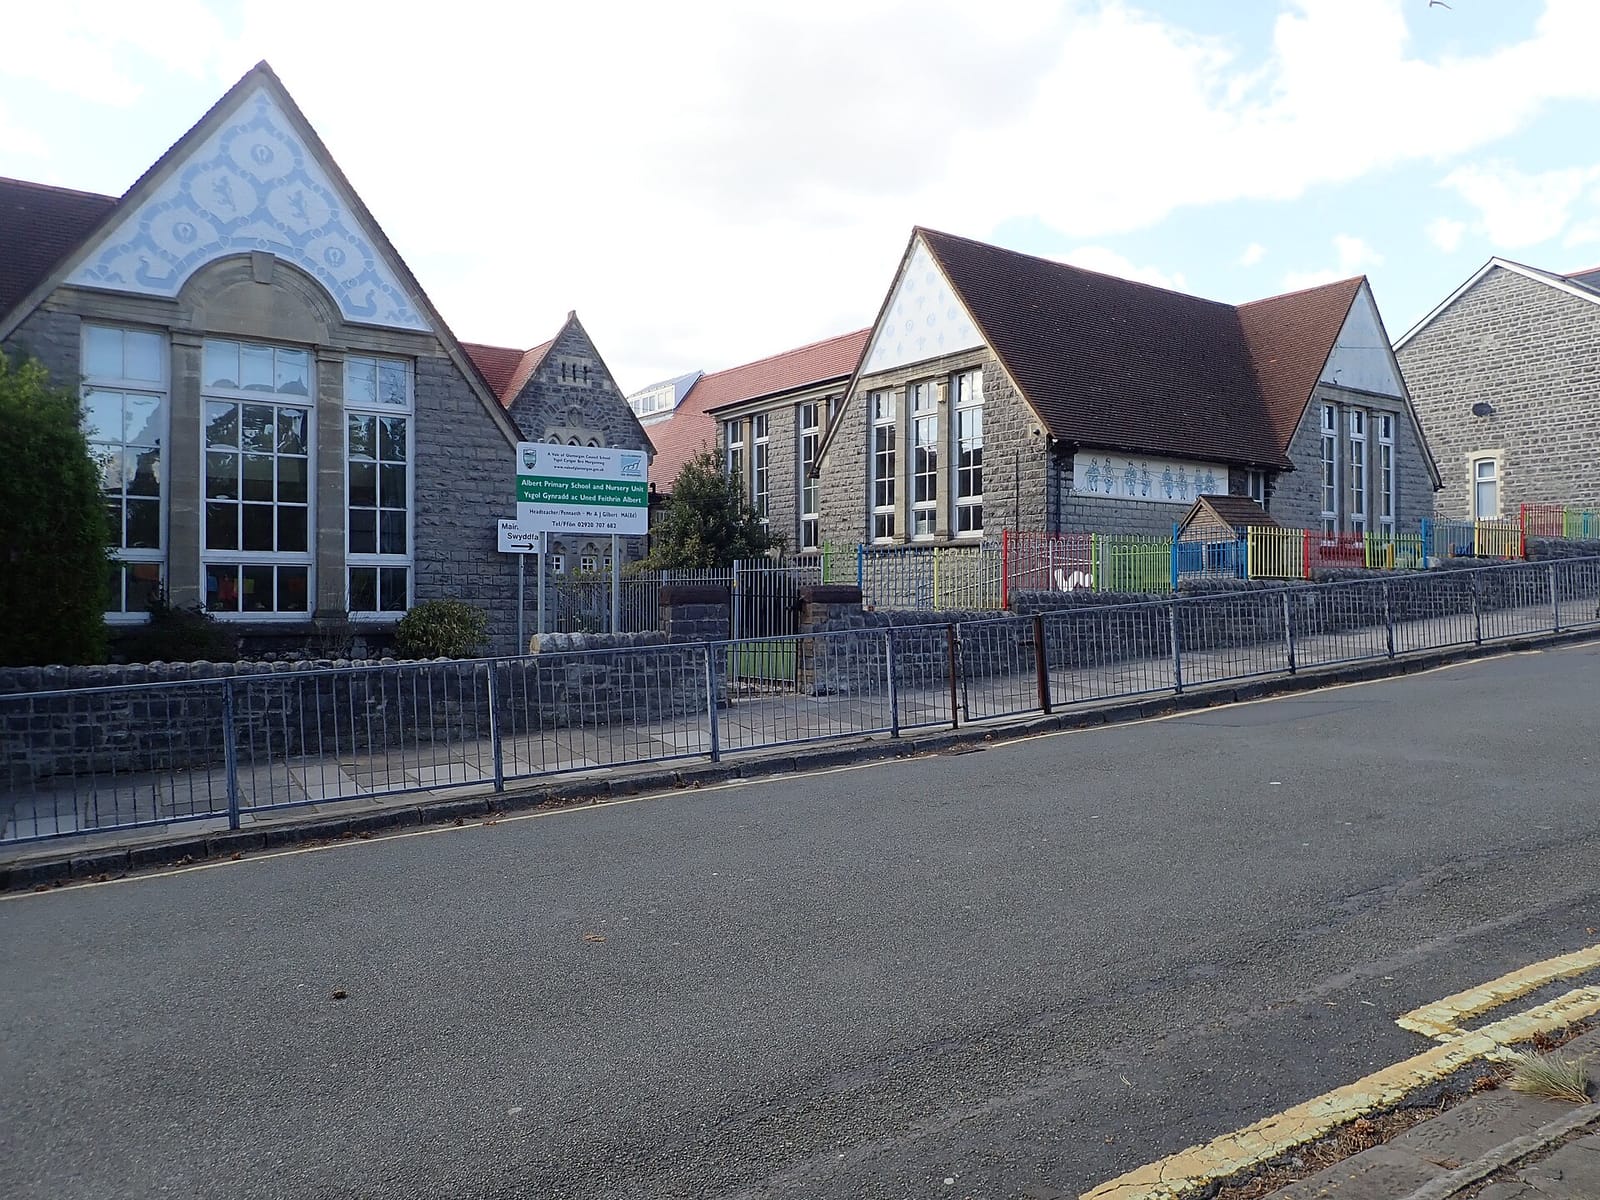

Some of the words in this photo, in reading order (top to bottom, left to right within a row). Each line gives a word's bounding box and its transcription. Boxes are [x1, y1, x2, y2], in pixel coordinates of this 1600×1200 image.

[521, 479, 542, 487] Albert
[544, 480, 569, 490] Primary
[570, 481, 591, 489] School
[605, 484, 629, 493] Nursery
[631, 485, 644, 493] Unit
[524, 491, 541, 499] Ysgol
[542, 492, 569, 501] Gynradd
[579, 494, 597, 502] Uned
[597, 495, 621, 503] Feithrin
[622, 496, 642, 504] Albert
[507, 532, 539, 541] Swyddfa
